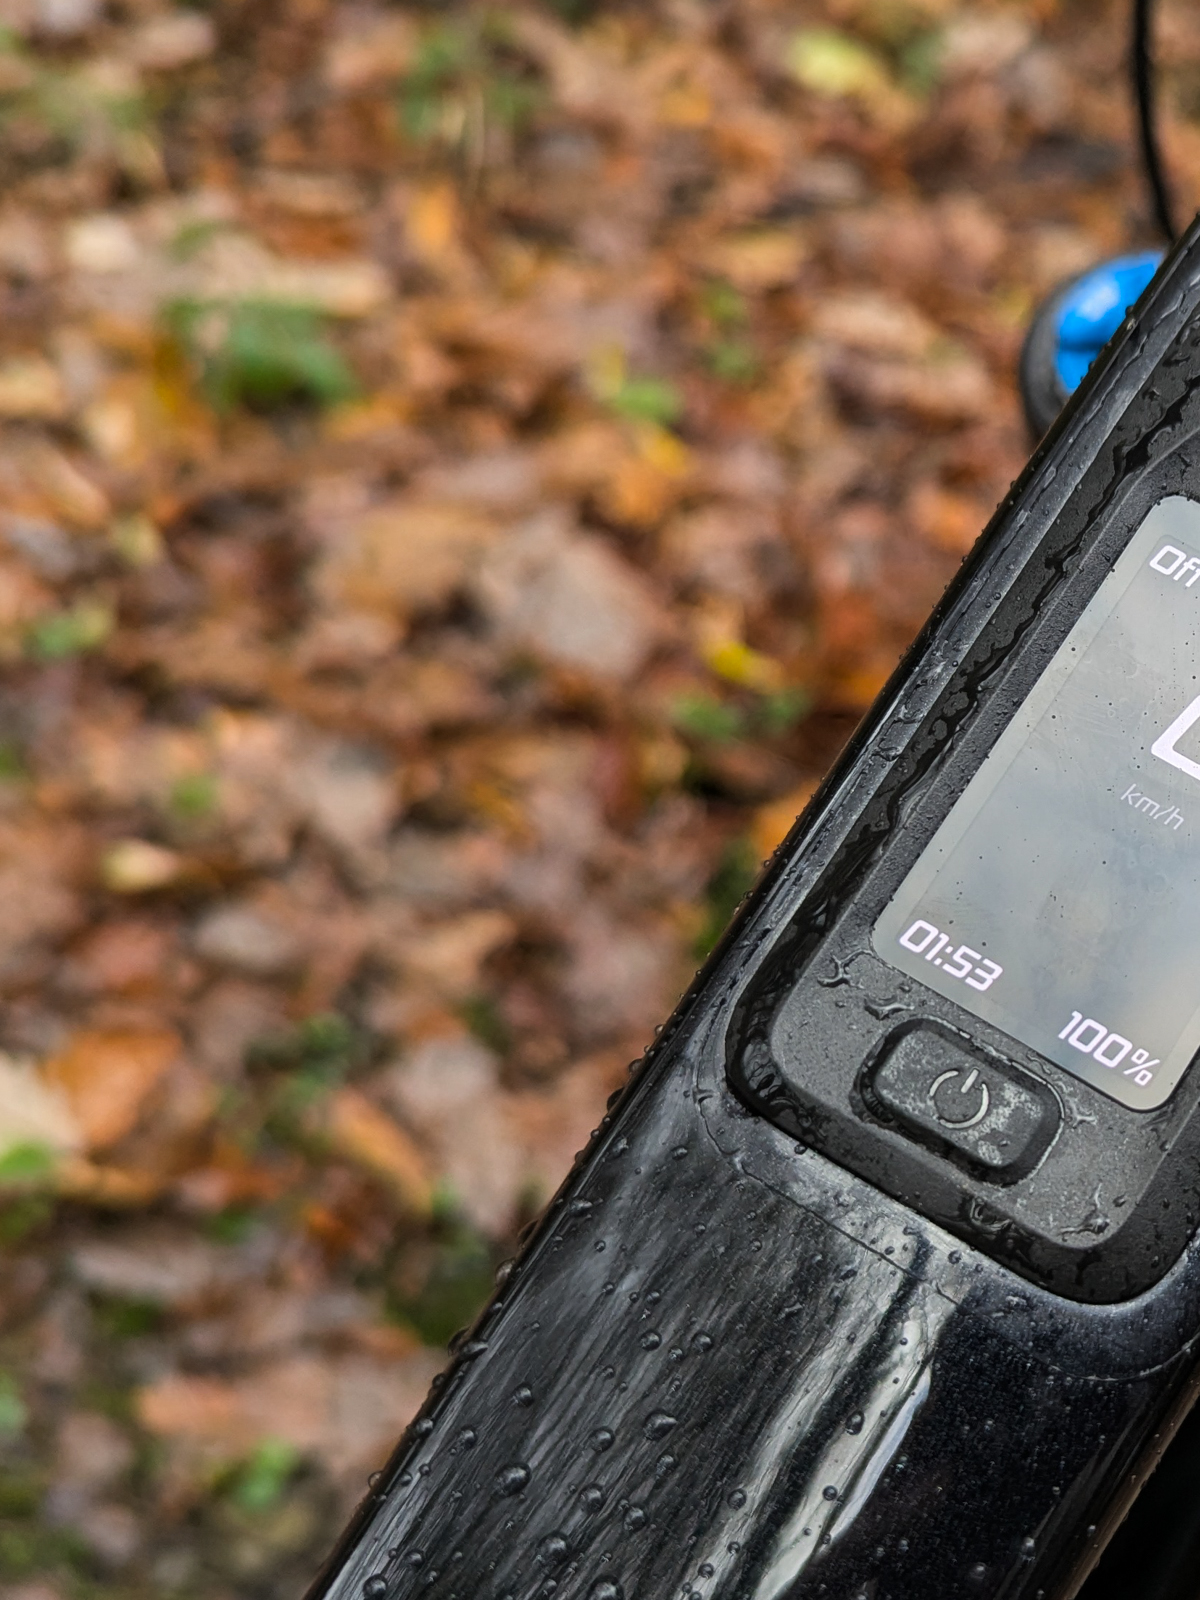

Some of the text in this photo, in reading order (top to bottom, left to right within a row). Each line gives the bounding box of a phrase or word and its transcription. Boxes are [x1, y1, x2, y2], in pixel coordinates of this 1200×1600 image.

[1120, 783, 1185, 830] km/h
[898, 918, 1003, 992] 01:53
[1057, 1010, 1161, 1087] 100%
